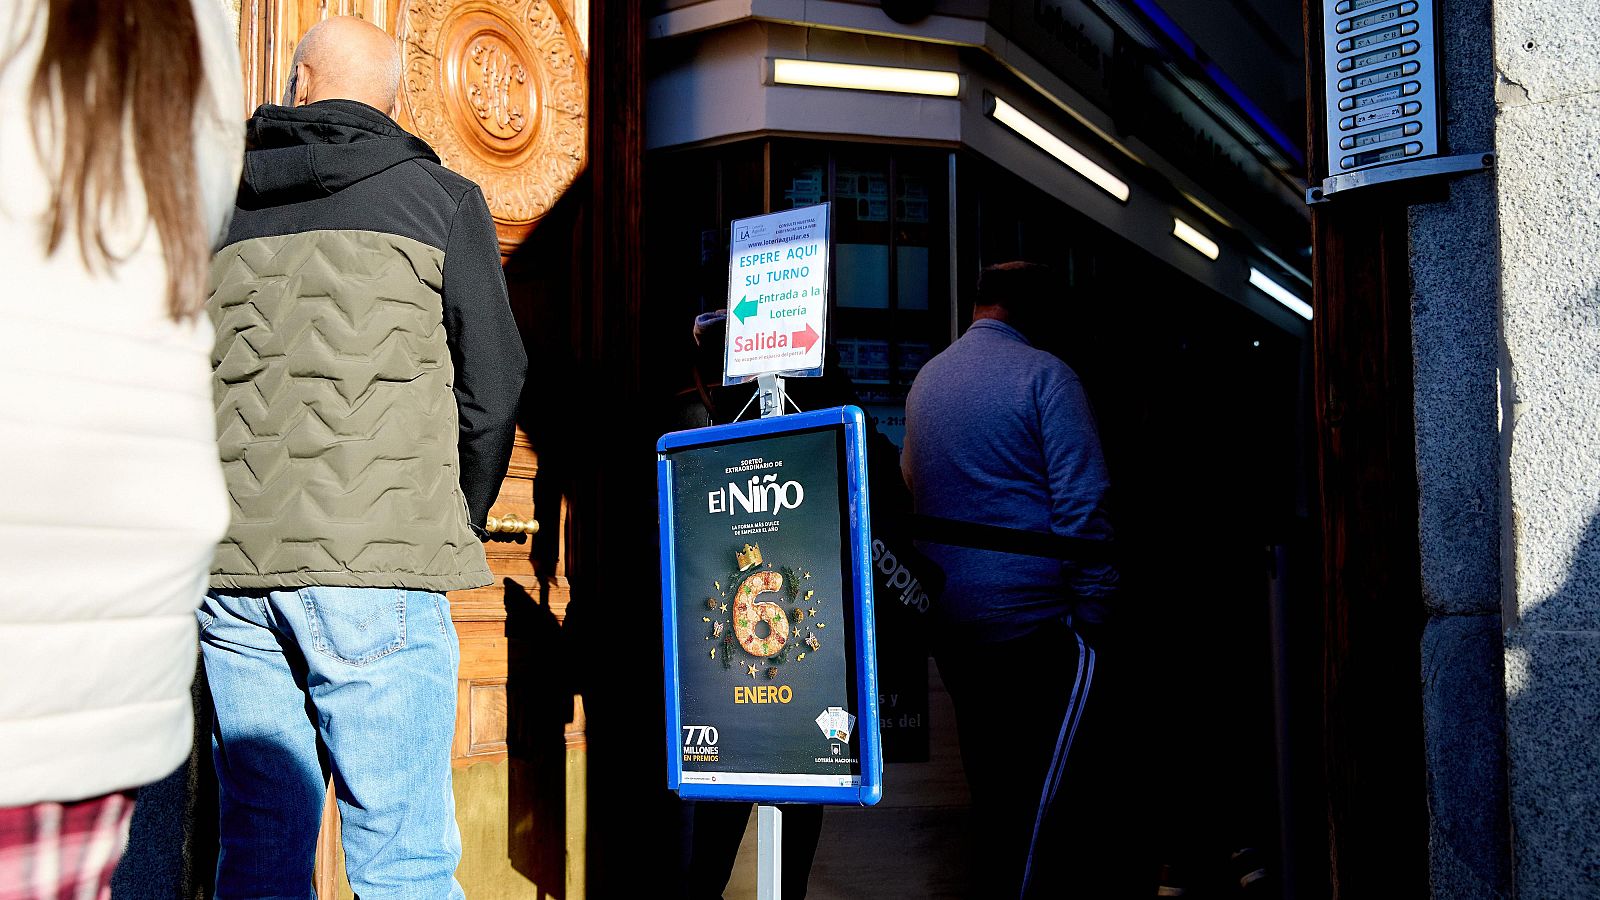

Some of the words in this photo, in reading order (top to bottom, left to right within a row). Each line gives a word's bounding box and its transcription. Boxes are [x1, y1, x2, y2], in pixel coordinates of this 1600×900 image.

[740, 231, 750, 240] LA
[740, 250, 780, 268] ESPERE
[787, 244, 818, 260] AQUI
[745, 273, 760, 287] SU
[767, 266, 809, 283] TURNO
[759, 289, 798, 304] Entrada
[802, 290, 808, 298] a
[811, 286, 820, 296] la
[770, 305, 807, 319] Lotería
[734, 331, 788, 353] Salida
[887, 416, 906, 426] 21:0
[725, 461, 774, 474] EXTRAORDINARIO
[740, 457, 763, 466] SORTEO
[708, 486, 726, 514] El
[728, 473, 804, 516] Niño
[872, 538, 930, 615] adidas
[732, 570, 790, 657] 6
[734, 685, 793, 704] ENERO
[898, 714, 921, 728] del
[682, 725, 719, 746] 770
[683, 746, 719, 755] MILLONES
